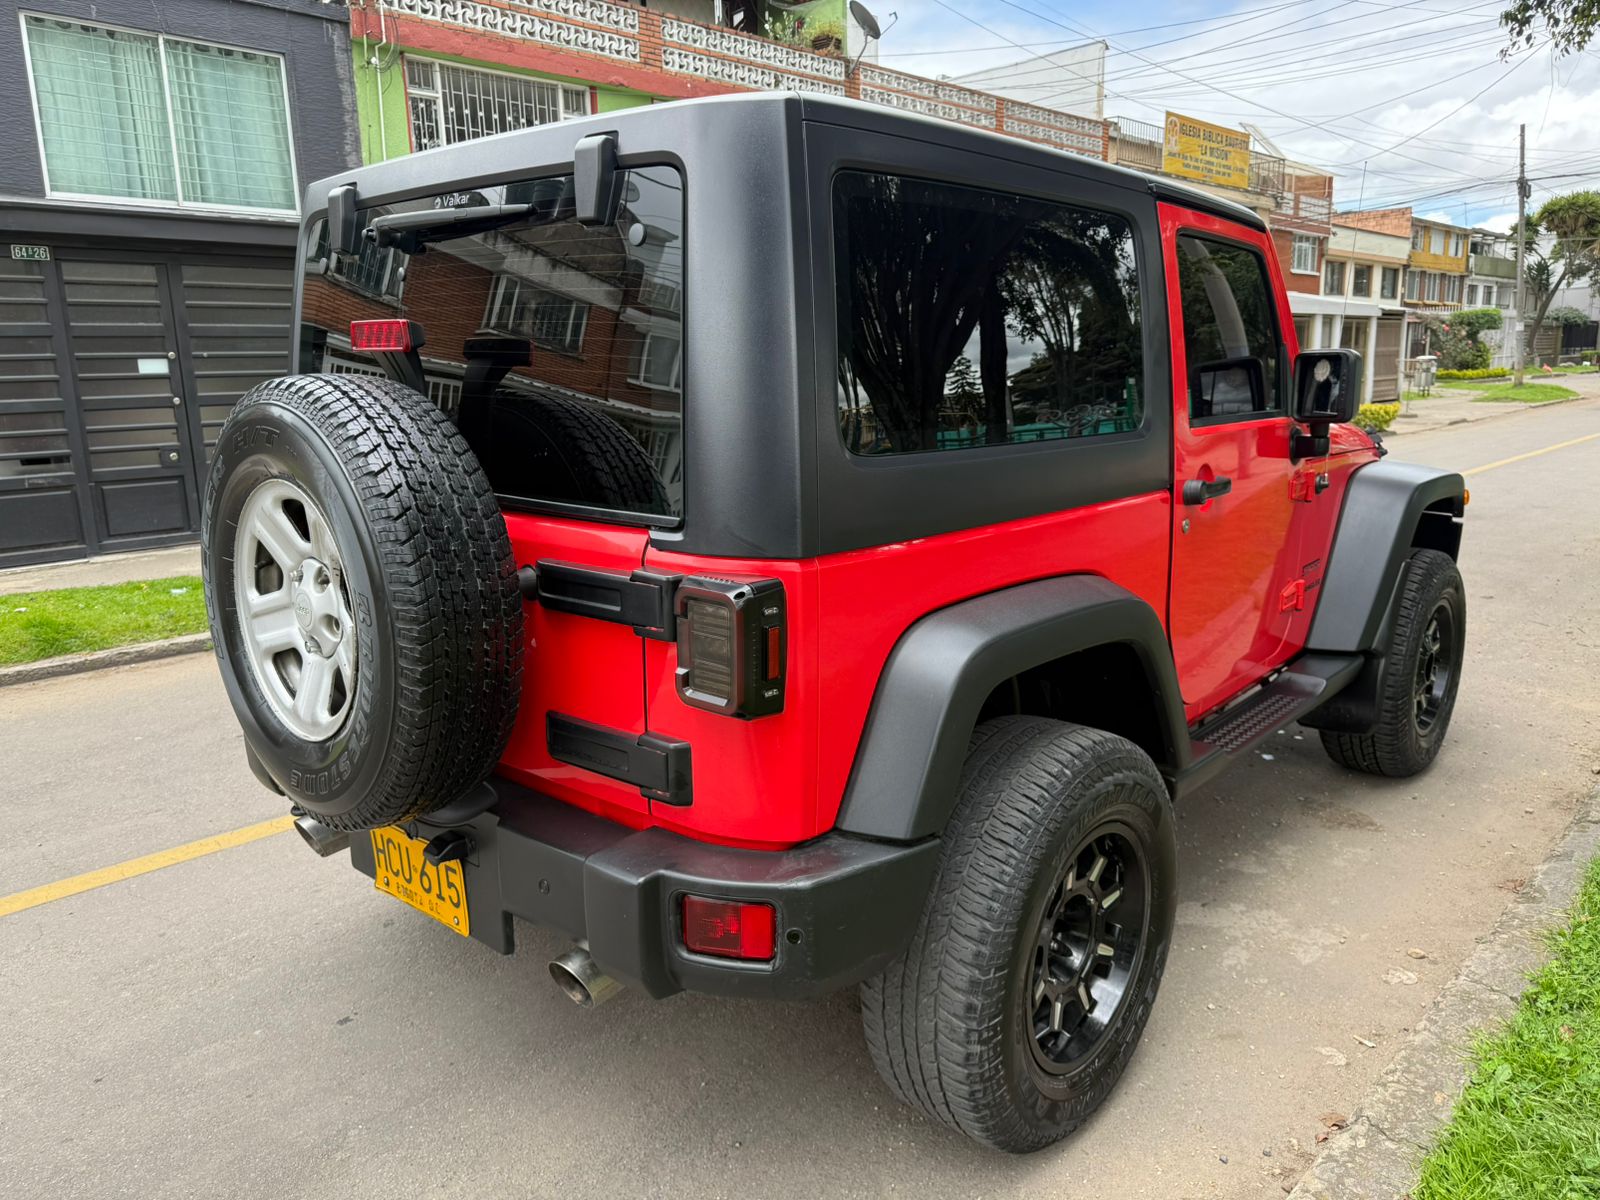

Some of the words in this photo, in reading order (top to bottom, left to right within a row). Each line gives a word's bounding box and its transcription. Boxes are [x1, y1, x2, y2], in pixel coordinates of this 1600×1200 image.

[1180, 123, 1201, 139] IGLESIA
[442, 192, 470, 208] Valkar
[290, 591, 375, 796] BRIDGESTONE
[372, 830, 413, 885] HCU
[419, 857, 461, 909] 615
